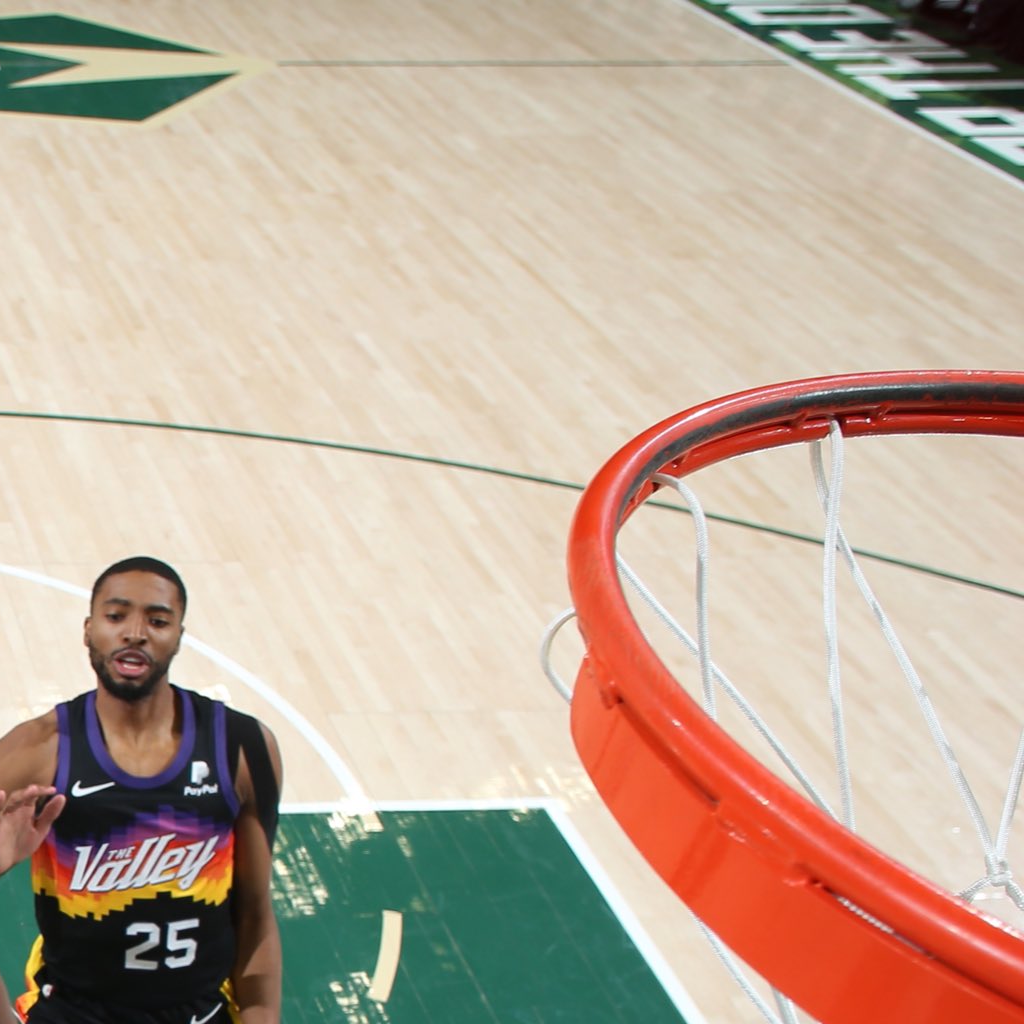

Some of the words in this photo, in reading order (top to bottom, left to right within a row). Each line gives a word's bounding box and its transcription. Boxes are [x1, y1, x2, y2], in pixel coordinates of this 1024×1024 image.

[184, 783, 218, 797] PayPal
[69, 834, 219, 893] Valley
[108, 846, 136, 860] THE
[124, 918, 200, 970] 25
